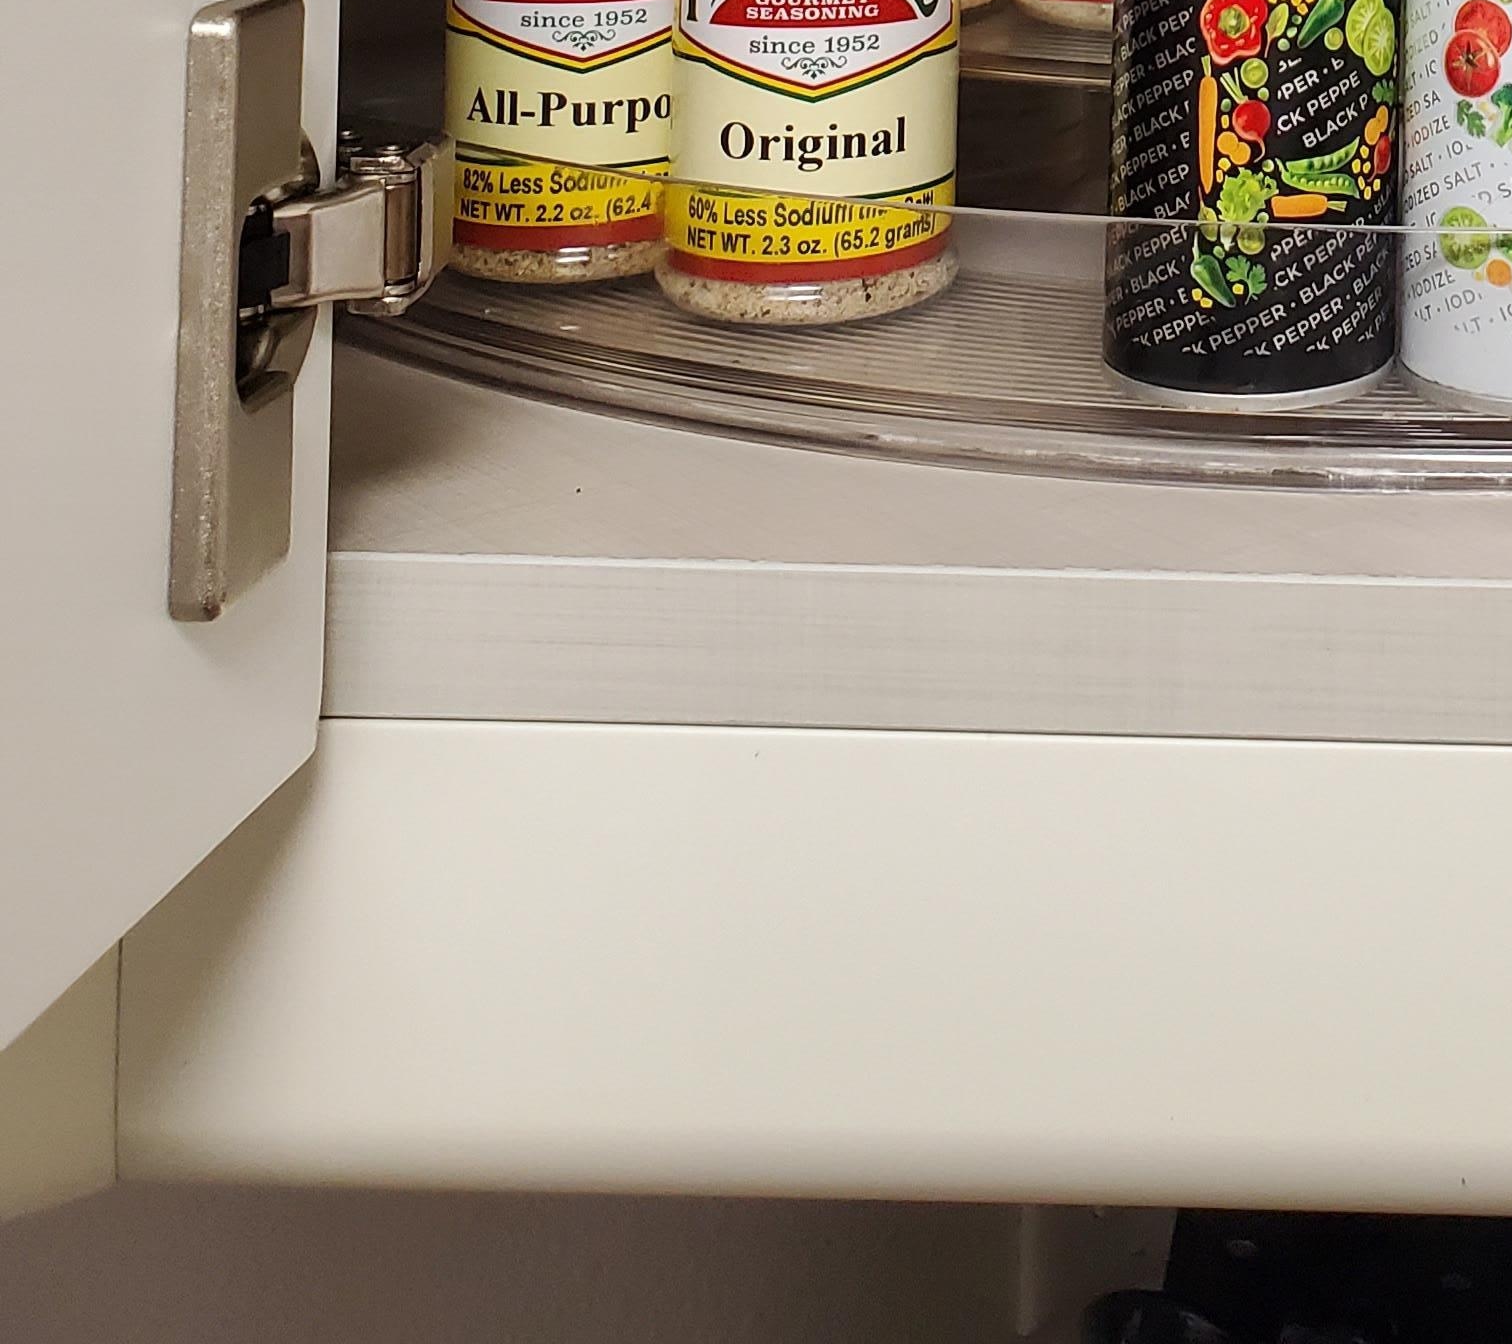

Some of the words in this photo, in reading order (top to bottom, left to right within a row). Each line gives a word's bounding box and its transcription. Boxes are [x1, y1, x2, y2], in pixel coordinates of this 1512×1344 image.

[520, 11, 585, 29] since
[593, 8, 648, 28] 1952
[745, 3, 880, 20] SEASONING
[748, 36, 816, 55] since
[824, 33, 881, 54] 1952
[466, 85, 673, 134] All-Purpo
[1301, 102, 1359, 149] BLACK
[719, 116, 907, 173] Original
[463, 167, 494, 194] 82%
[499, 171, 543, 195] Less
[1443, 161, 1484, 191] SALT
[460, 198, 490, 220] NET
[495, 202, 530, 223] WT.
[535, 203, 565, 223] 2.2
[606, 192, 651, 223] (62.4
[688, 194, 718, 224] 60%
[723, 200, 768, 227] Less
[687, 224, 717, 248] NET
[720, 230, 756, 255] WT.
[761, 235, 790, 256] 2.3
[796, 238, 828, 255] oz.
[834, 226, 880, 258] (65.2
[1208, 303, 1288, 352] PEPPER
[1299, 254, 1356, 305] BLACK
[1272, 296, 1344, 351] PEPPER
